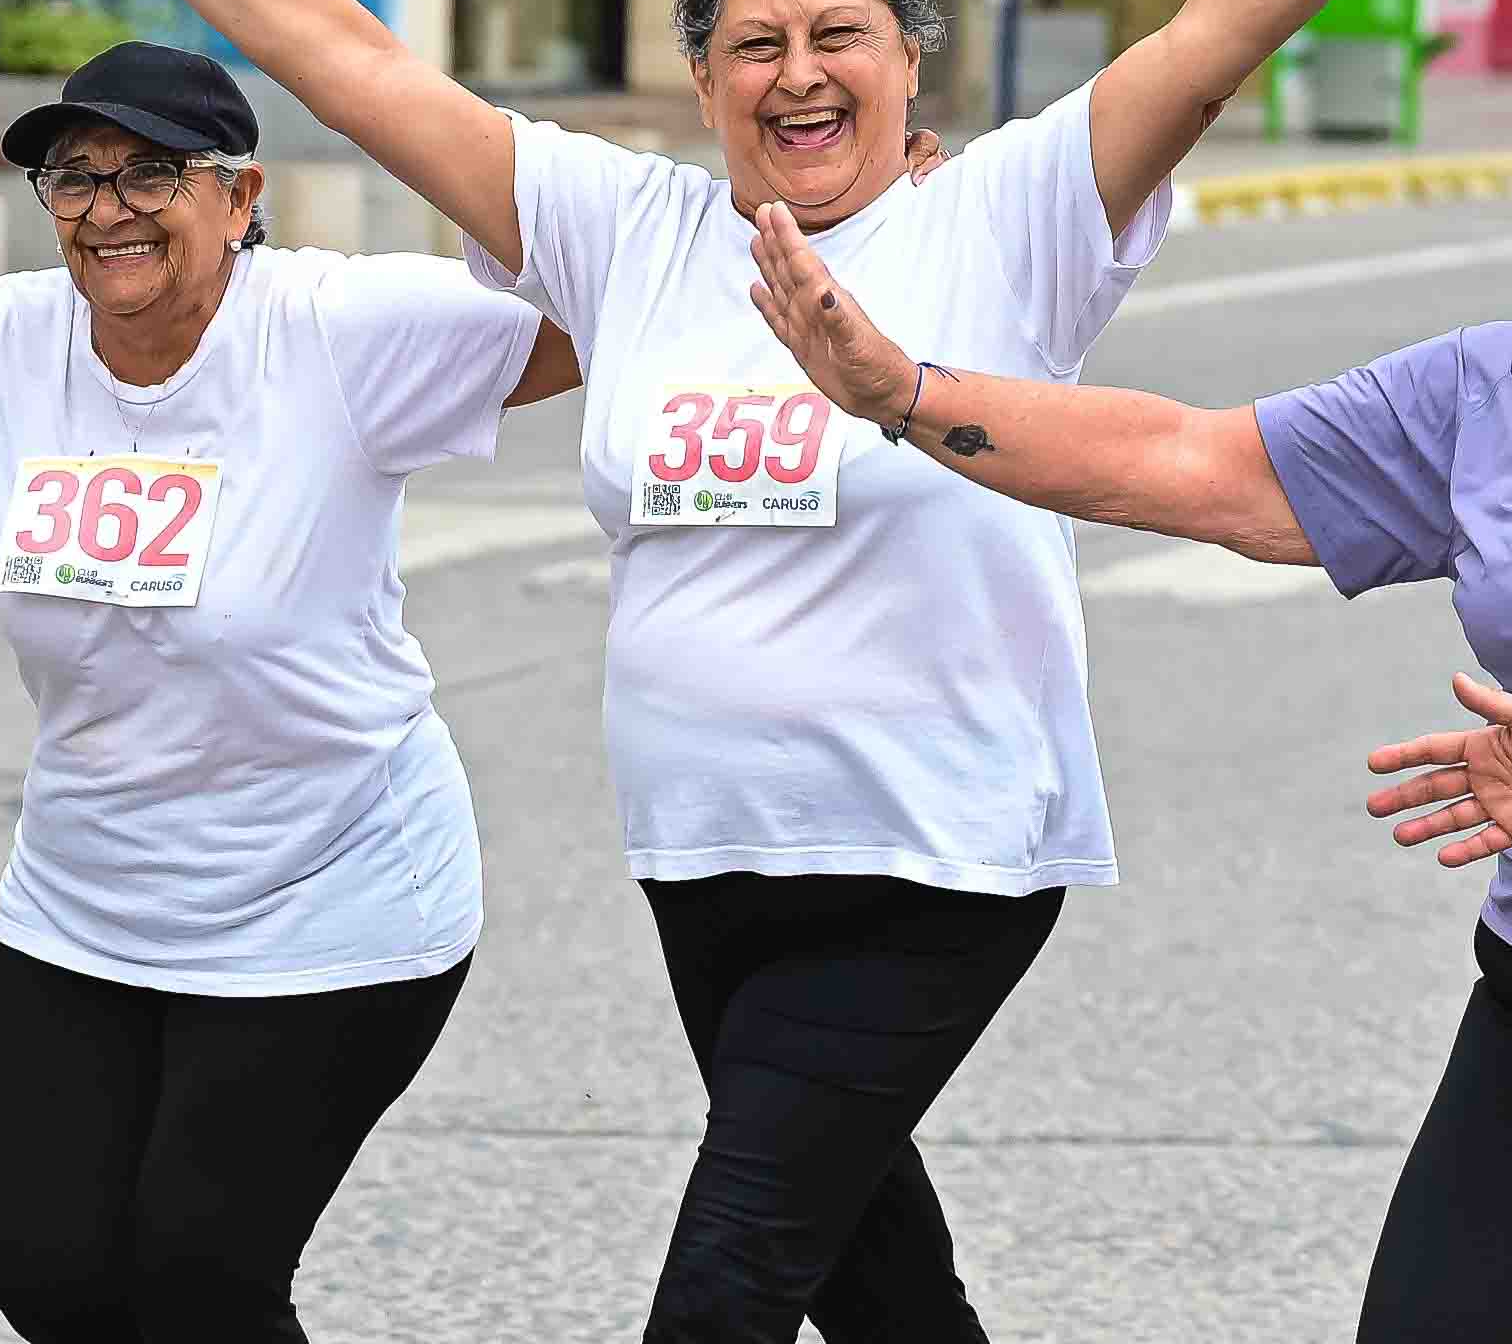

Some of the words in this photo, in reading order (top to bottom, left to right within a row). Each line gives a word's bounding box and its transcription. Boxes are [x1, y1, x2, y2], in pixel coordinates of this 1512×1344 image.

[648, 392, 831, 484] 359
[15, 467, 202, 567] 362
[762, 497, 819, 511] CARUSO
[130, 579, 184, 592] CARUSO
